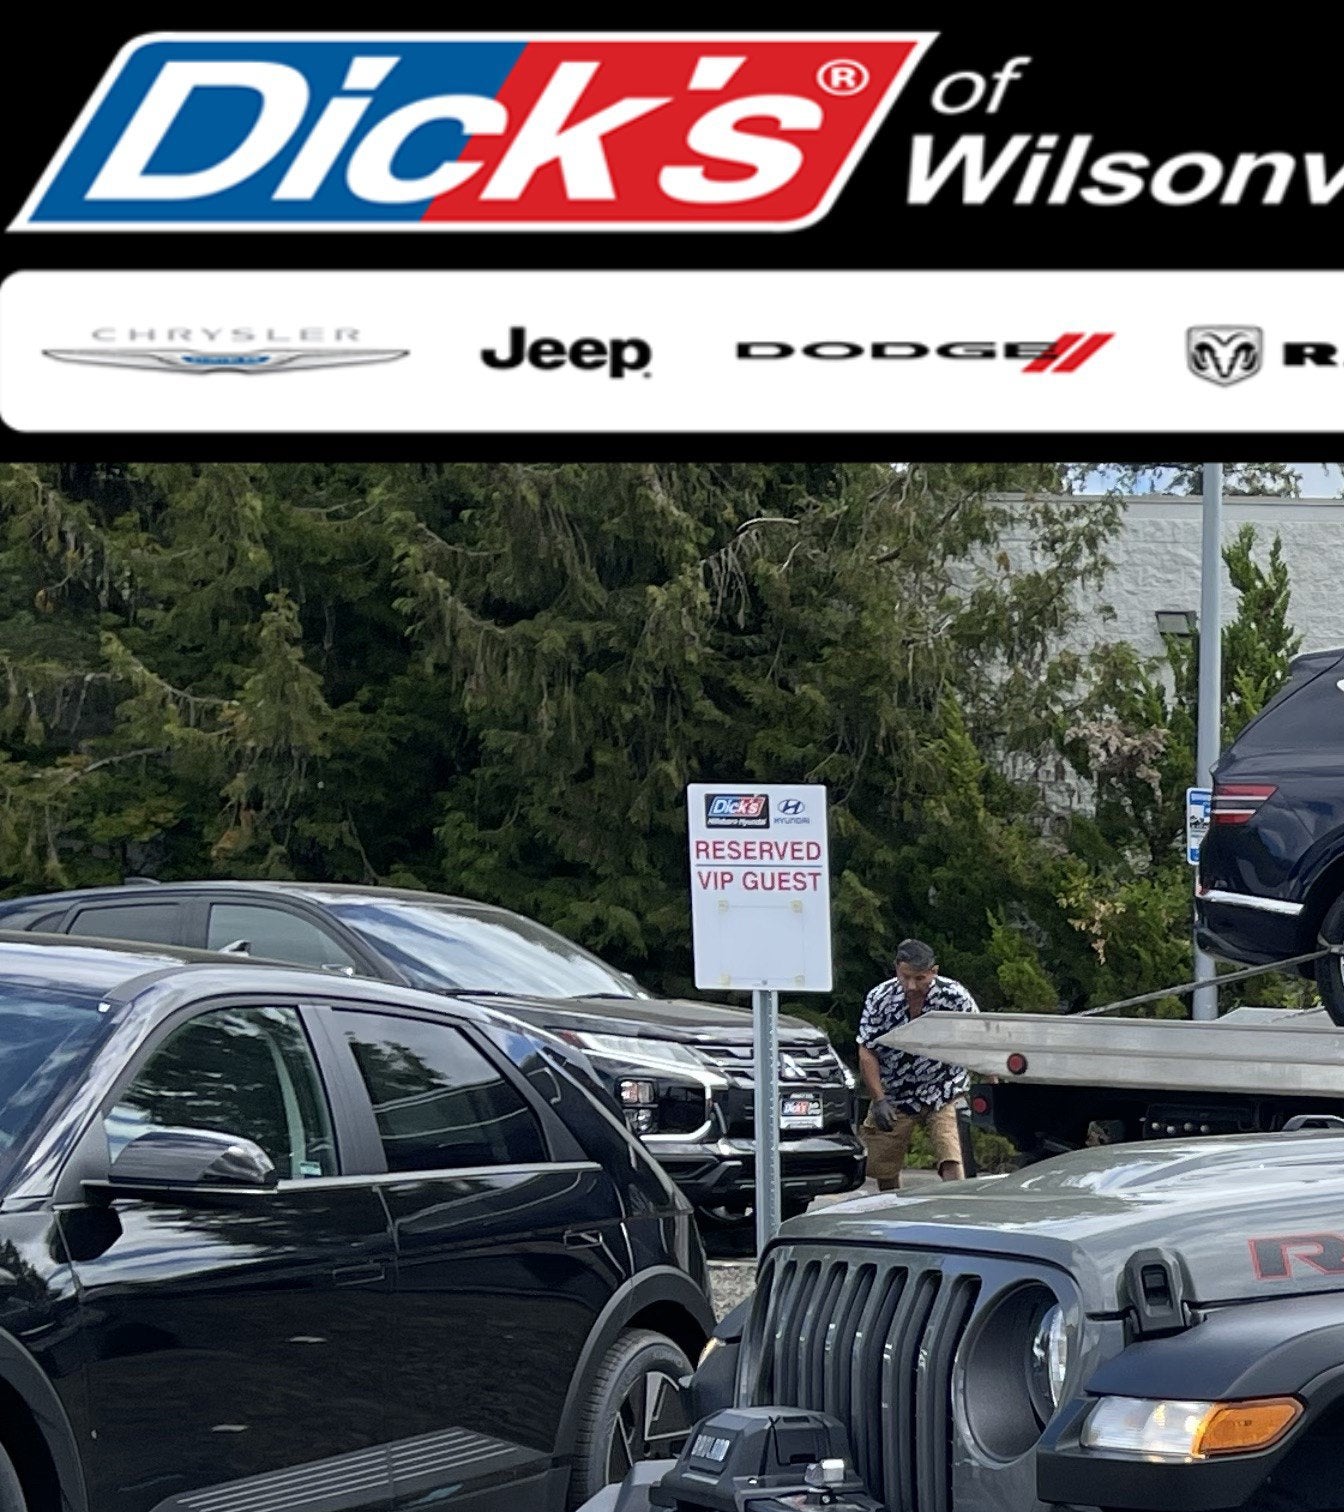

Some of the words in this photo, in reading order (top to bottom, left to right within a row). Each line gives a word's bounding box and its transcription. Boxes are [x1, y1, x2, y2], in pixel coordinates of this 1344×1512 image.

[695, 840, 822, 861] RESERVED
[697, 871, 734, 891] VIP
[742, 871, 822, 892] GUEST
